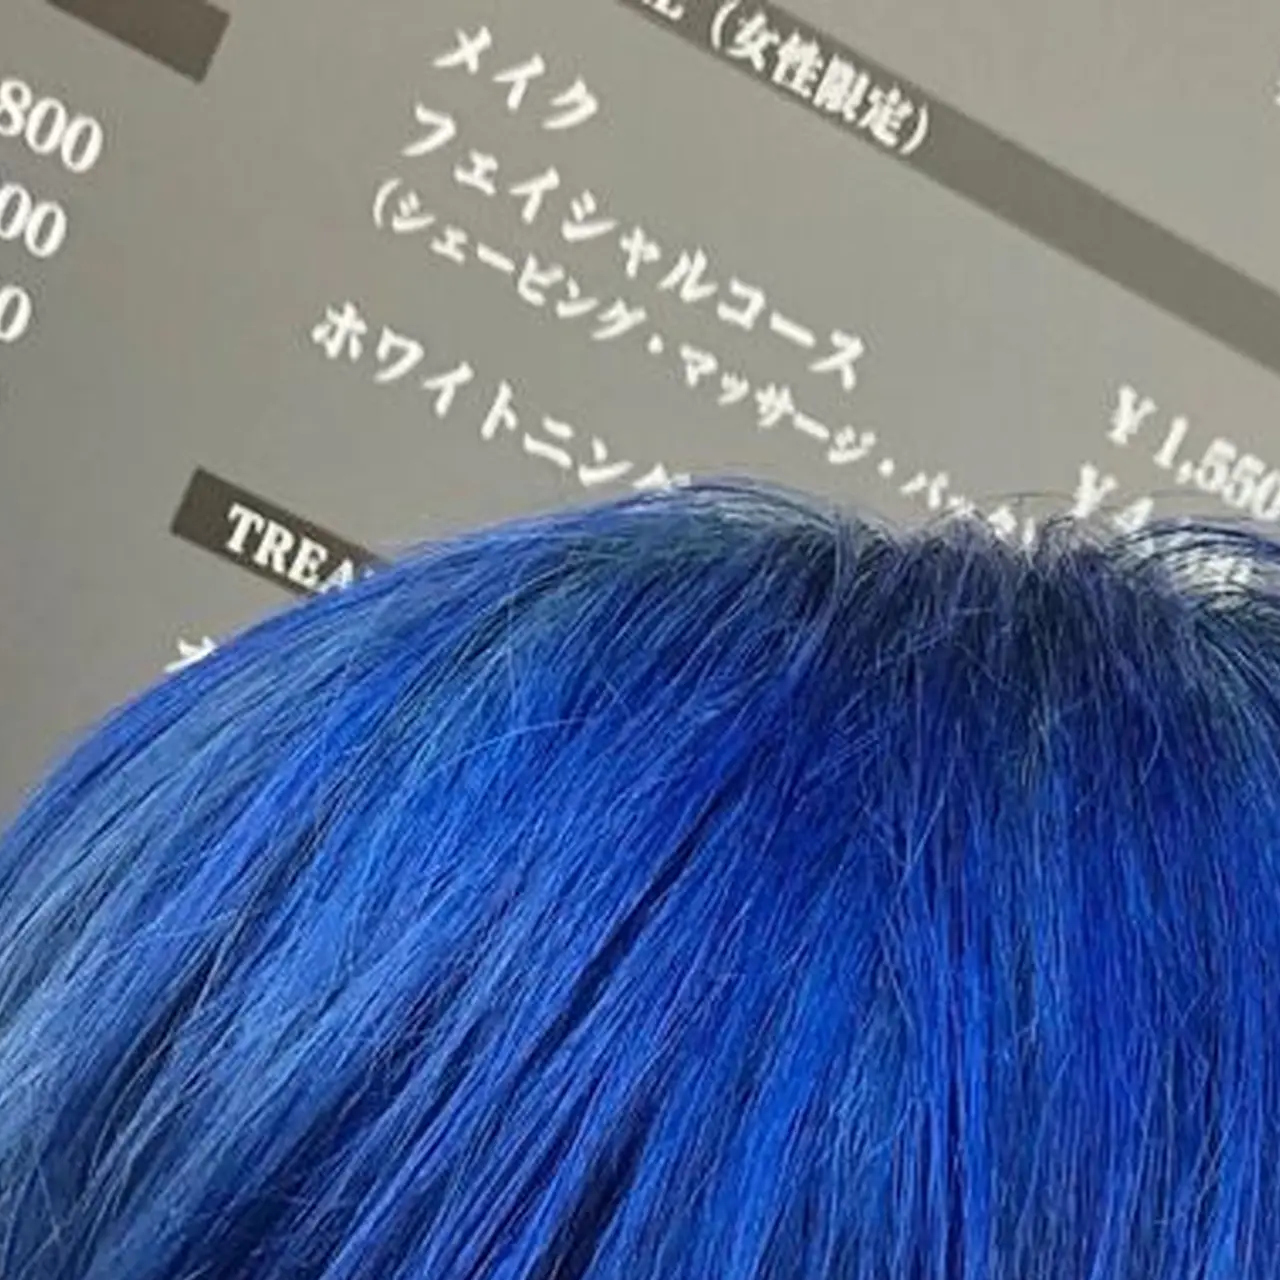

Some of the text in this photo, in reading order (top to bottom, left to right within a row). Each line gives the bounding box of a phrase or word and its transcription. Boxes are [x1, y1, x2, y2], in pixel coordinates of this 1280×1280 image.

[434, 26, 597, 129] メイク
[404, 104, 864, 390] フェイシャルコース
[228, 504, 374, 595] TREA
